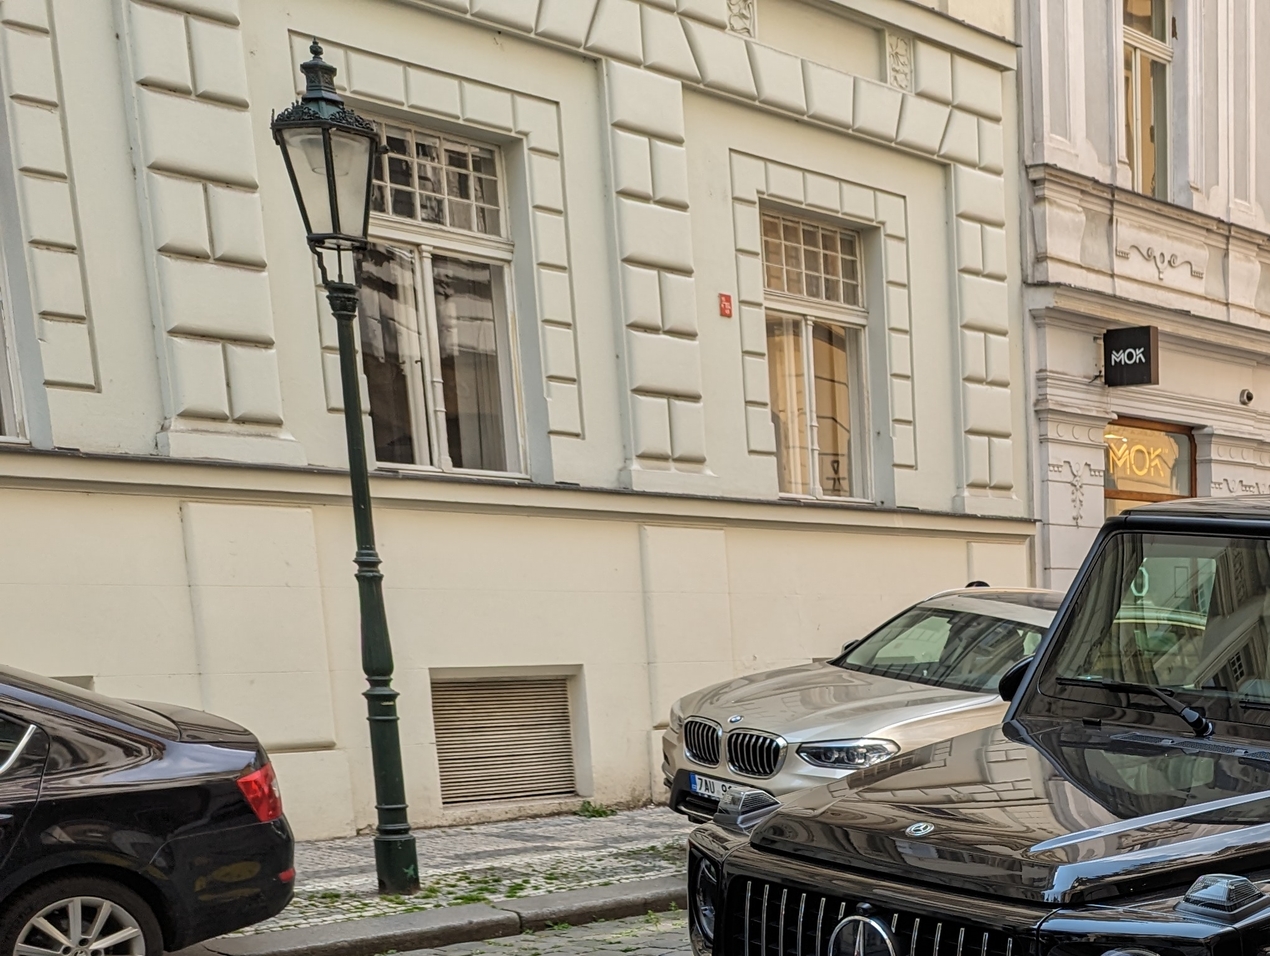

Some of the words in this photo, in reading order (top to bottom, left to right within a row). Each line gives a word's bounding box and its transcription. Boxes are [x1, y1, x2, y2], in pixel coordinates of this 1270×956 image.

[1111, 347, 1146, 366] MOK
[1109, 442, 1164, 477] MOK
[697, 778, 715, 794] 7AU
